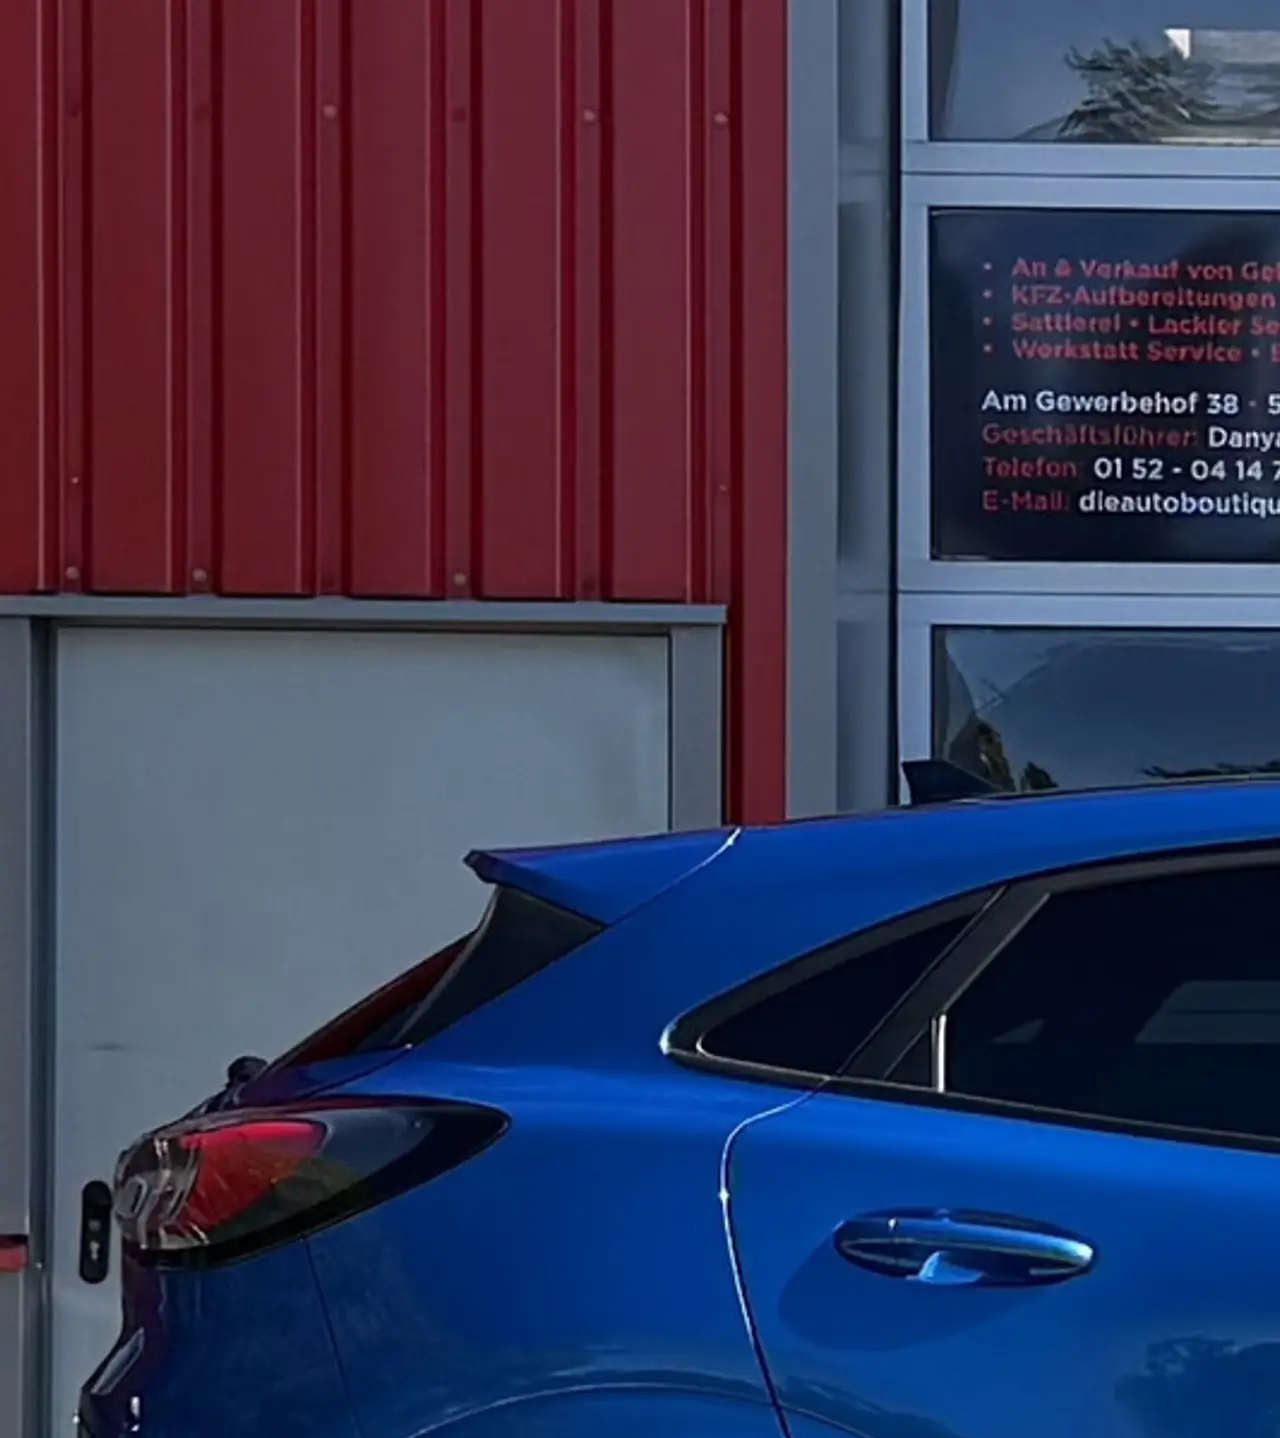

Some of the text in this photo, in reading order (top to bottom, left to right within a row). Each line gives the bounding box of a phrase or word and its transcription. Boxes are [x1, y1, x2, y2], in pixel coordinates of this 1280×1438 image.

[1012, 258, 1047, 277] An
[1079, 259, 1179, 278] Verkauf
[1188, 264, 1233, 280] von
[1011, 284, 1277, 310] KFZ-Aufbereitungen
[1011, 312, 1121, 332] Sattlerei
[1148, 314, 1242, 335] Lackier
[1012, 338, 1139, 360] Werkstatt
[1147, 341, 1242, 362] Service
[981, 390, 1027, 411] Am
[1035, 390, 1199, 413] Gewerbehof
[1206, 393, 1240, 415] 38
[1093, 457, 1123, 479] 01
[1132, 458, 1164, 480] 52
[1190, 460, 1227, 480] 04
[1236, 460, 1264, 481] 14
